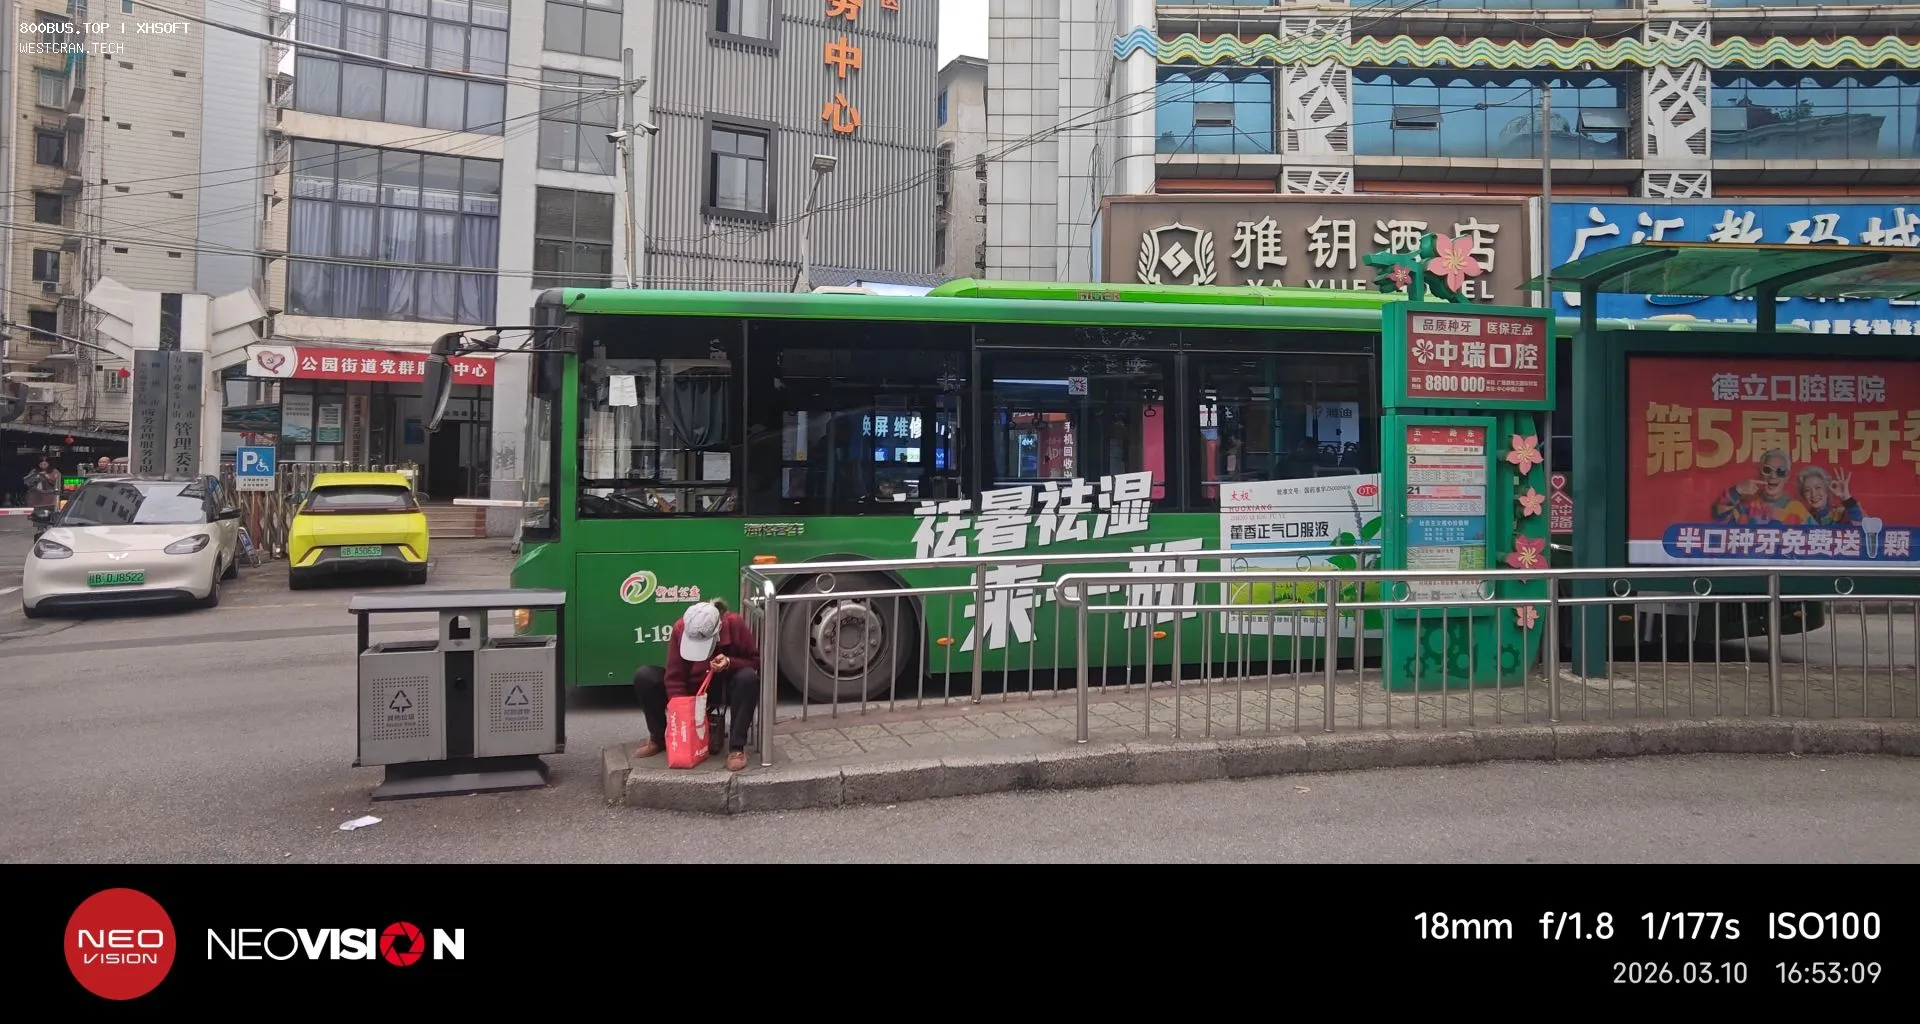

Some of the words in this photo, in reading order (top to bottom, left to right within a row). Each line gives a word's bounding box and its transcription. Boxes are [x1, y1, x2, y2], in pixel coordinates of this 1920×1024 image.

[1230, 214, 1500, 273] 雅钥酒店
[1422, 319, 1472, 334] 品质种牙
[1487, 321, 1534, 336] 医保定点
[1435, 339, 1538, 370] 中瑞口腔
[301, 355, 488, 379] 公园街道党群中心
[1425, 374, 1458, 392] 8800
[1460, 376, 1486, 393] 000
[1711, 372, 1886, 403] 德立口腔医院
[173, 421, 193, 473] 管理委
[242, 451, 258, 472] P
[1409, 456, 1417, 465] 3
[1407, 486, 1421, 495] 21
[911, 470, 1154, 560] 祛暑祛湿
[1230, 520, 1329, 540] 藿香正气口服液
[1676, 526, 1861, 557] 半口种牙免费送
[1884, 530, 1911, 557] 颗
